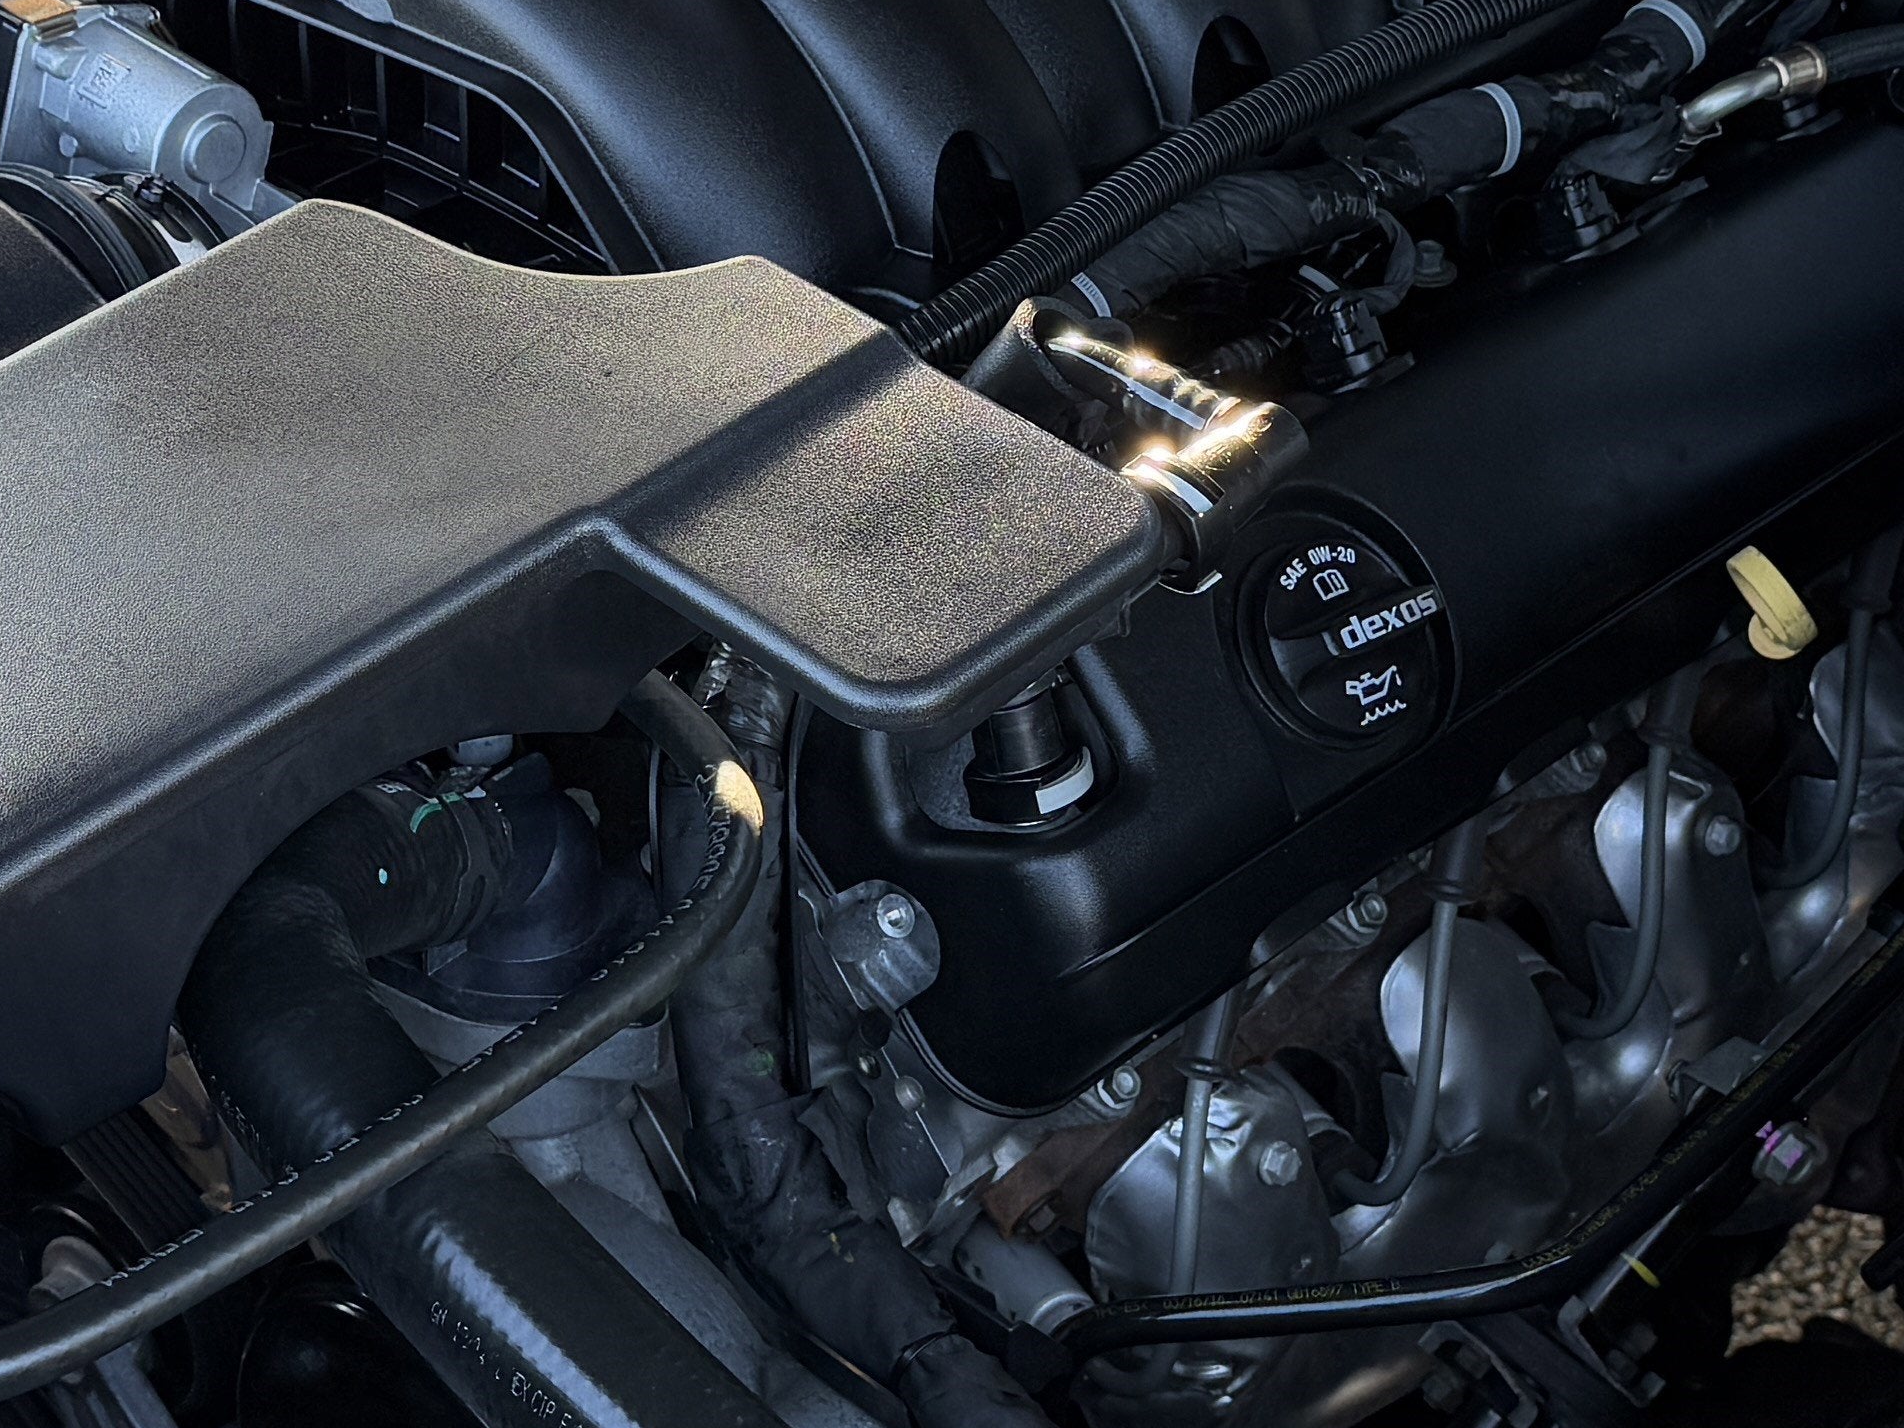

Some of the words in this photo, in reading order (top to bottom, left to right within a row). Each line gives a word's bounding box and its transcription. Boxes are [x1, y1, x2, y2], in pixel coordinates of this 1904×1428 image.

[1280, 557, 1308, 591] SAE
[1308, 545, 1356, 566] 0W-20
[1340, 590, 1438, 650] dexos
